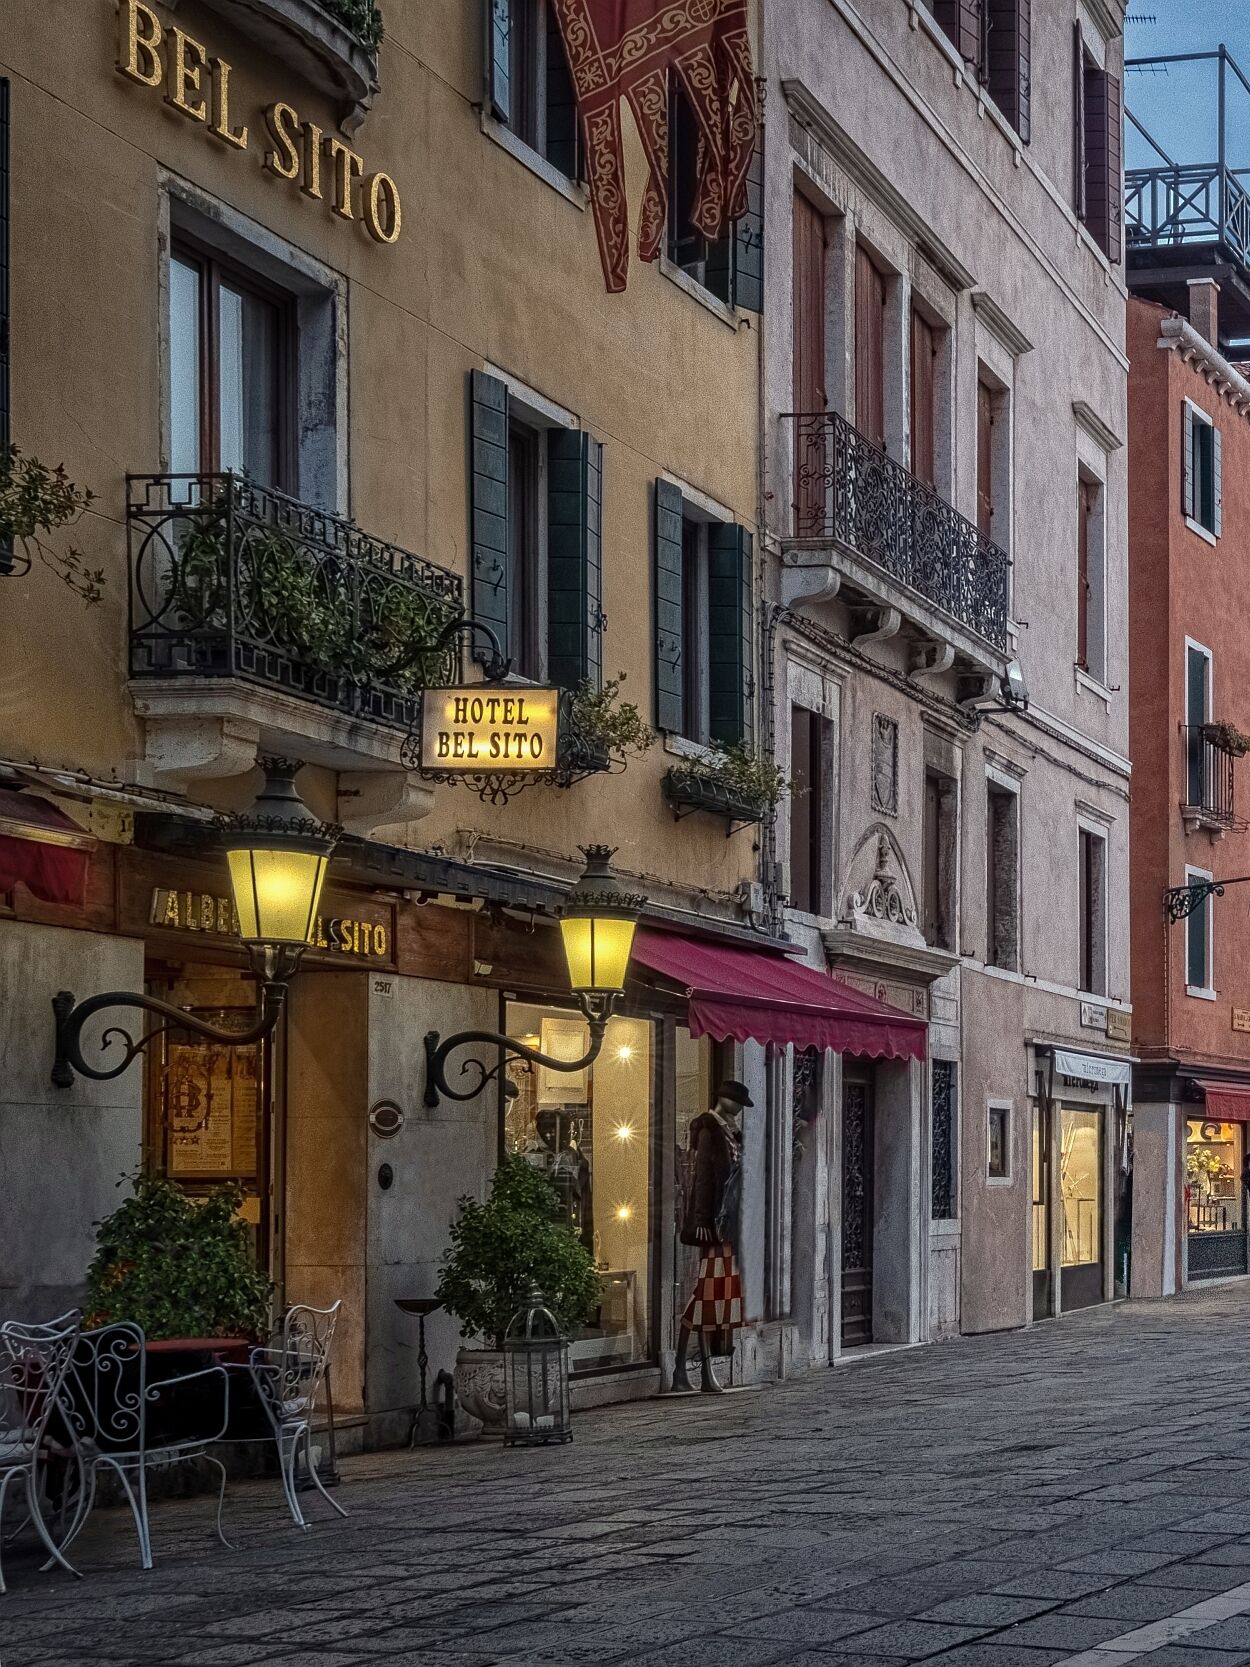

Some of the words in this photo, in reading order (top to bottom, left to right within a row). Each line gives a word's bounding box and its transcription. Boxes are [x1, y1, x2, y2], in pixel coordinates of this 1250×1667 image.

[122, 0, 249, 150] BEL
[268, 101, 402, 244] SITO
[453, 697, 529, 726] HOTEL
[437, 731, 479, 759] BEL
[489, 732, 543, 759] SITO
[337, 918, 387, 956] SITO
[374, 981, 393, 995] 2517
